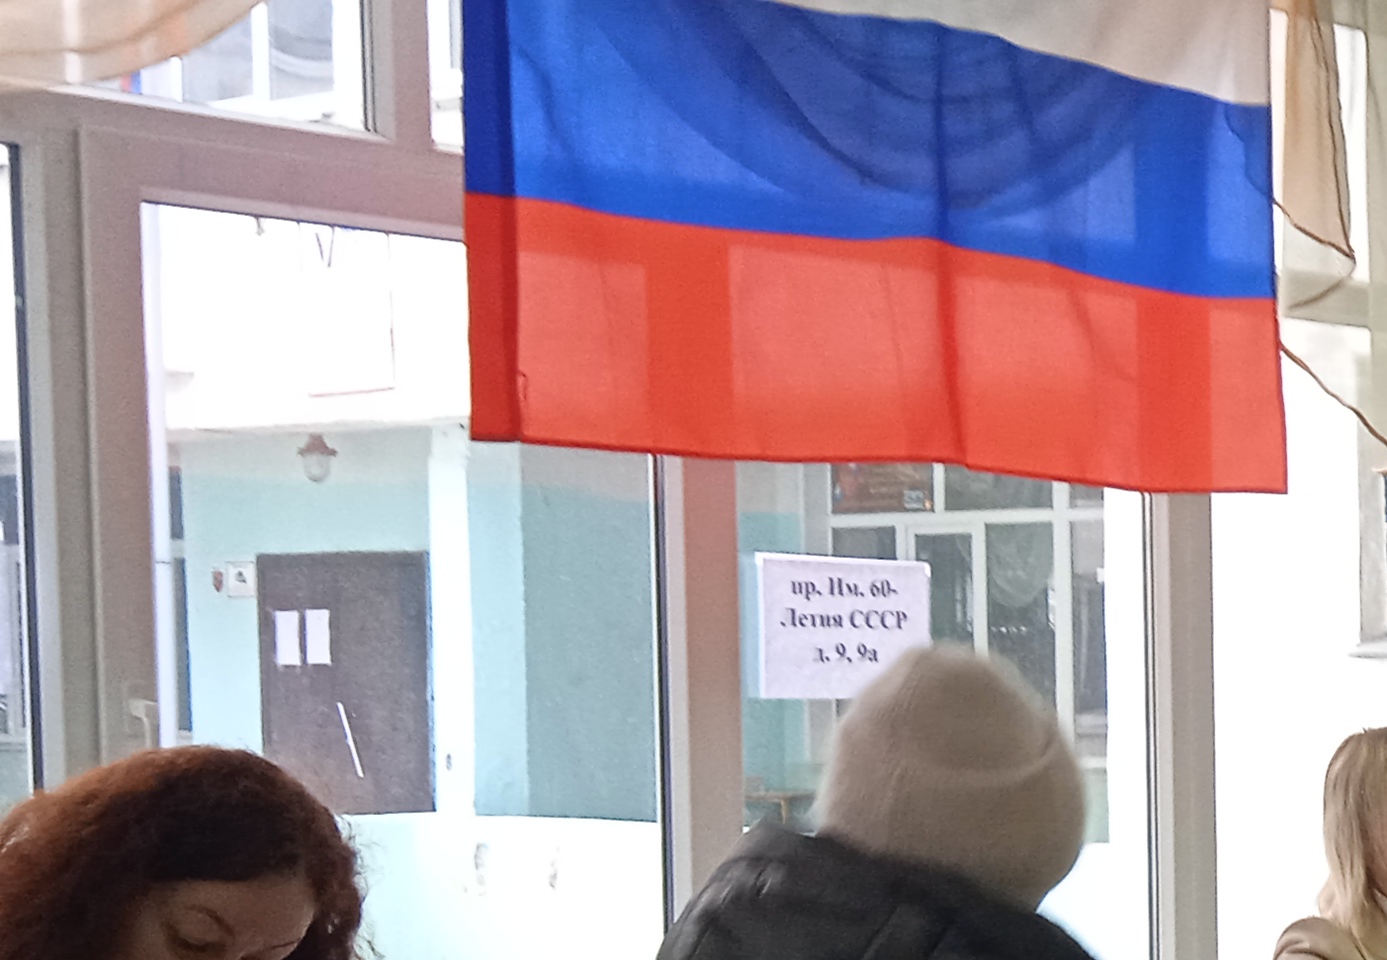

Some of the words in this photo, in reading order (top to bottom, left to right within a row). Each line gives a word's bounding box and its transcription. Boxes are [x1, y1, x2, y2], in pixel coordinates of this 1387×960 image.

[791, 579, 822, 601] пр.
[827, 576, 865, 597] Им.
[869, 579, 899, 597] 60-
[779, 607, 845, 630] Летия
[849, 609, 908, 630] СССР
[835, 642, 853, 663] 9,
[857, 642, 880, 663] 9а
